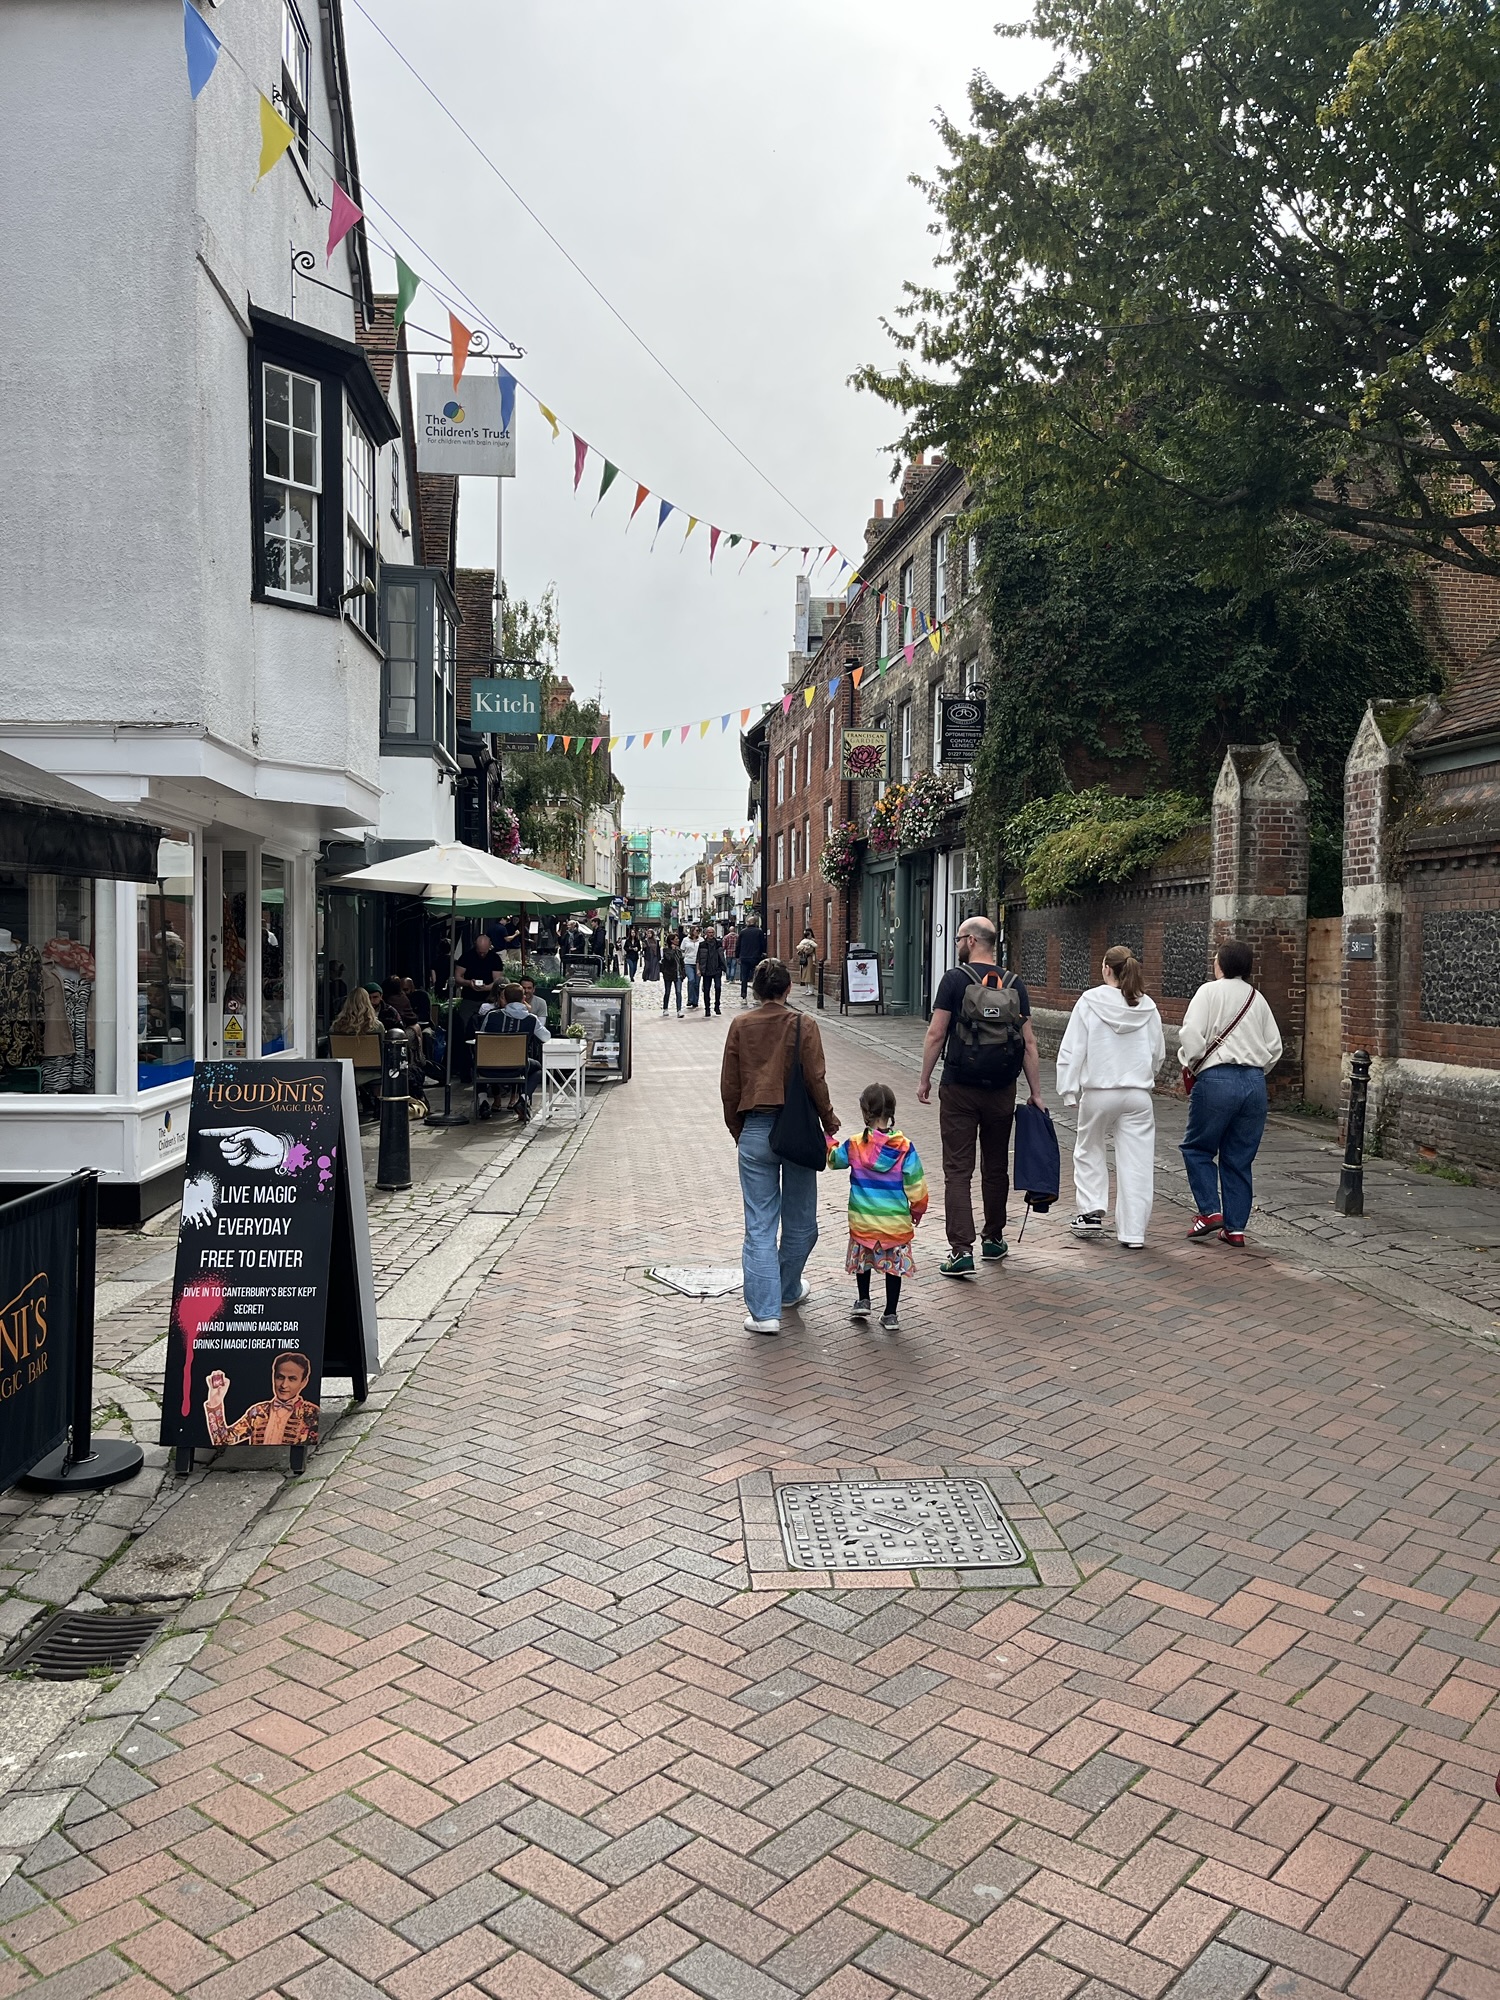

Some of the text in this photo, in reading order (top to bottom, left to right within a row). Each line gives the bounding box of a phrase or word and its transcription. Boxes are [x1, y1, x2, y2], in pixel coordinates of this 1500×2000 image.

[425, 414, 447, 425] The
[425, 426, 511, 439] Children's Trust
[492, 440, 510, 448] injury
[474, 692, 536, 713] Kitch
[936, 924, 943, 937] 9
[207, 1080, 326, 1104] HOUDINI'S
[271, 1104, 324, 1112] MAGIC BAR
[158, 1127, 166, 1138] The
[158, 1135, 177, 1151] Children's
[176, 1132, 186, 1143] Trust
[220, 1185, 297, 1204] LIVE MAGIC
[217, 1217, 292, 1236] EVERYDAY
[200, 1249, 303, 1268] FREE TO ENTER
[183, 1286, 317, 1297] DIVE IN TO CANTERBURY'S BEST KEPT
[233, 1304, 265, 1315] SECRET!
[196, 1321, 299, 1332] AWARD WINNING MAGIC BAR
[277, 1338, 300, 1350] TIMES
[0, 1351, 48, 1401] GIC BAR
